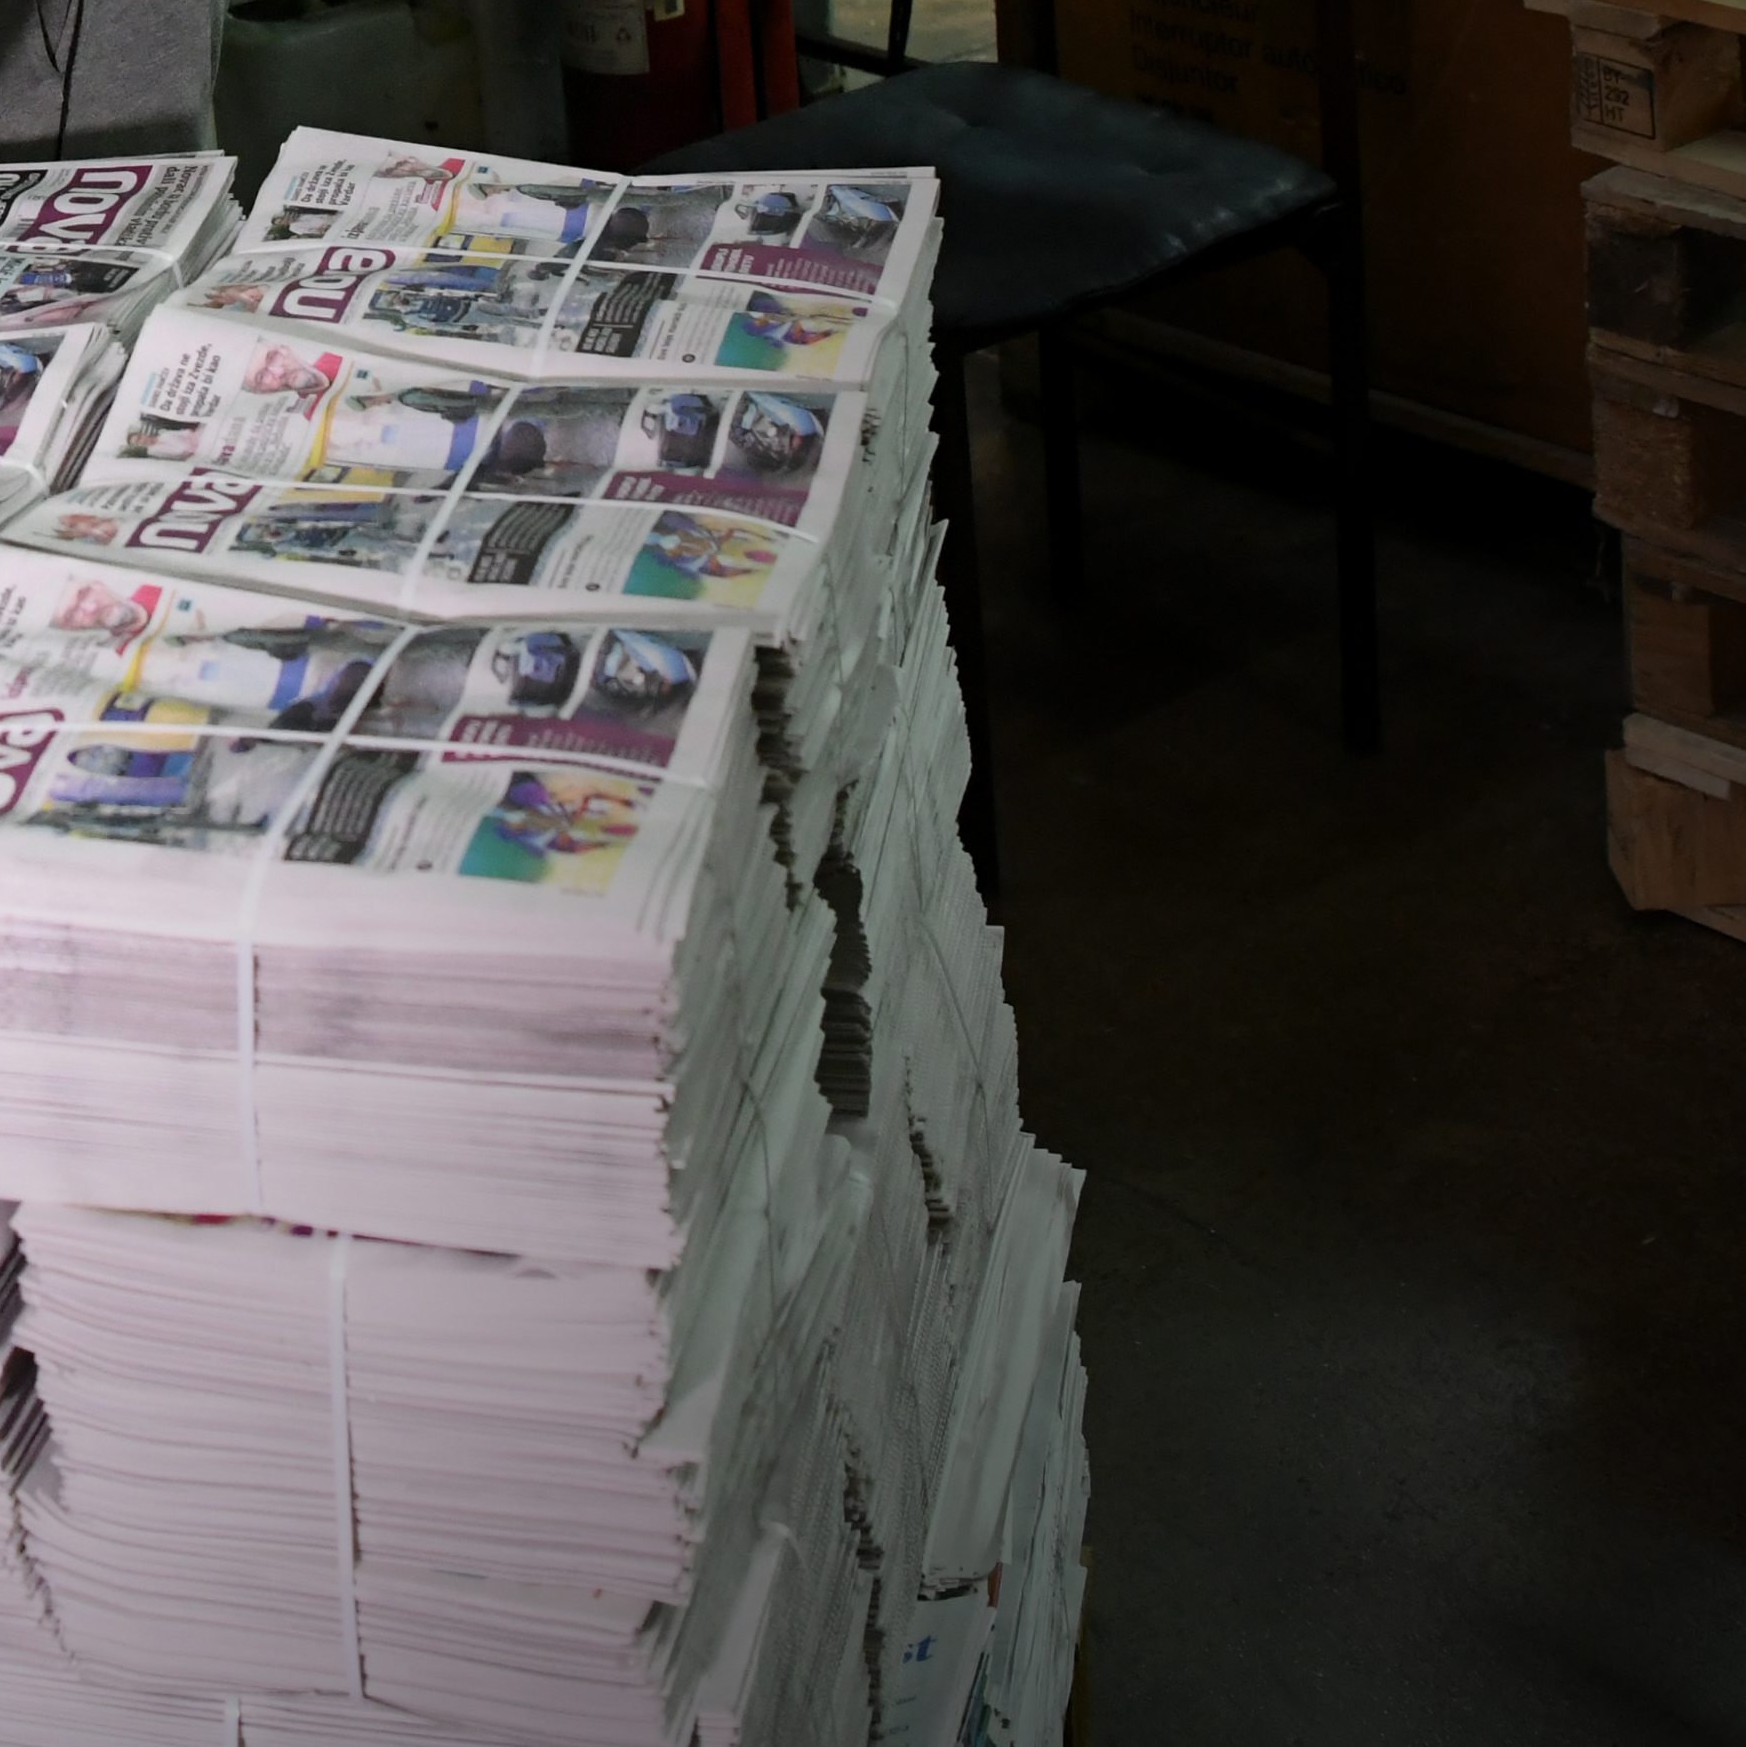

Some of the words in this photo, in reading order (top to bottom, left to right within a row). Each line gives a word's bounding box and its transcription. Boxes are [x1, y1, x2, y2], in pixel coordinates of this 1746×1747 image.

[180, 354, 191, 366] ne
[188, 343, 212, 380] Zvezde,
[205, 355, 221, 373] kao
[166, 368, 186, 398] država
[181, 381, 196, 395] iza
[160, 399, 173, 412] Da
